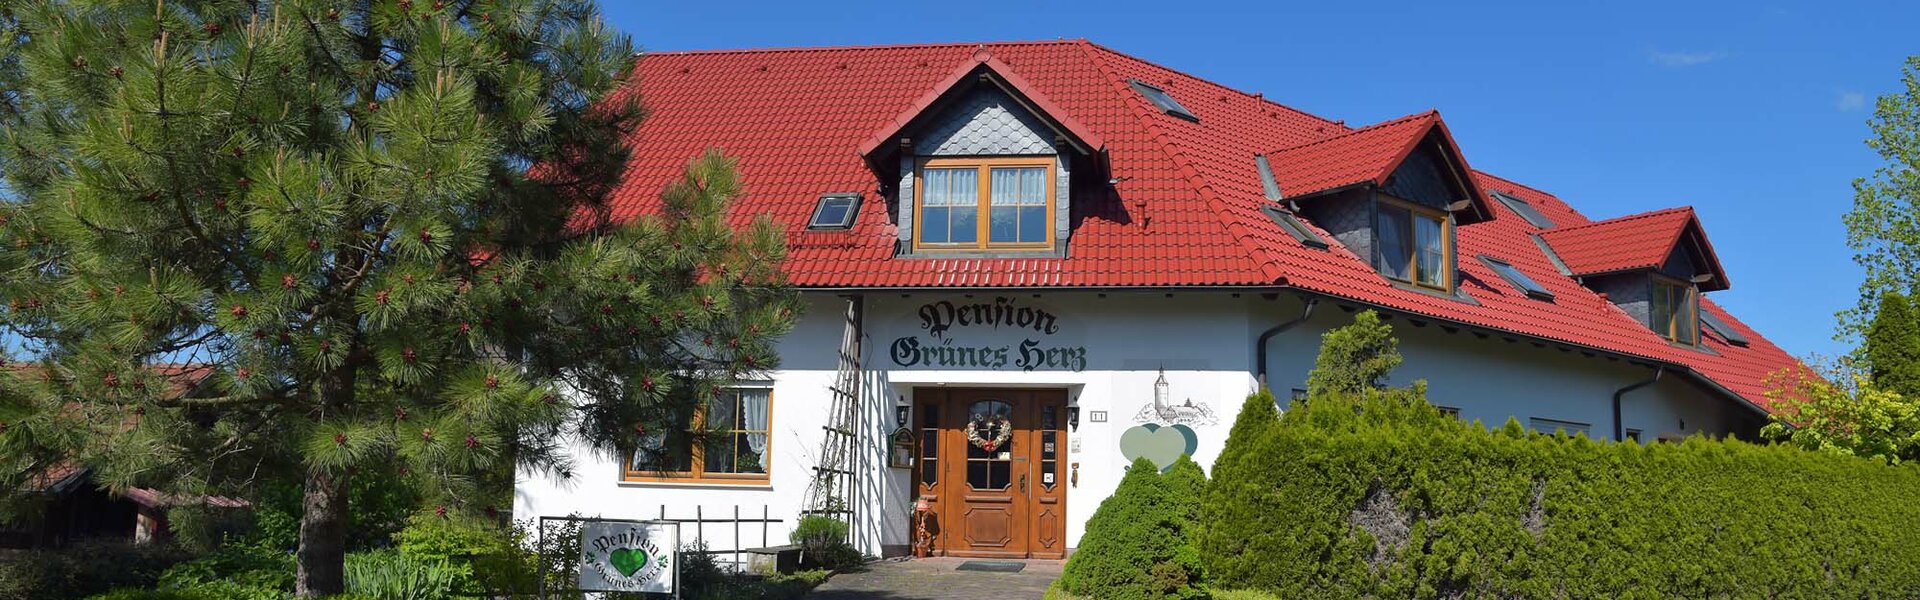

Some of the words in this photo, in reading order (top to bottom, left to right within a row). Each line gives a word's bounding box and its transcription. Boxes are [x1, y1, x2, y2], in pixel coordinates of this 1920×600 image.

[919, 297, 1059, 341] Pension
[890, 336, 1010, 371] Grünes
[1015, 338, 1087, 373] Herz
[592, 527, 660, 556] Pension
